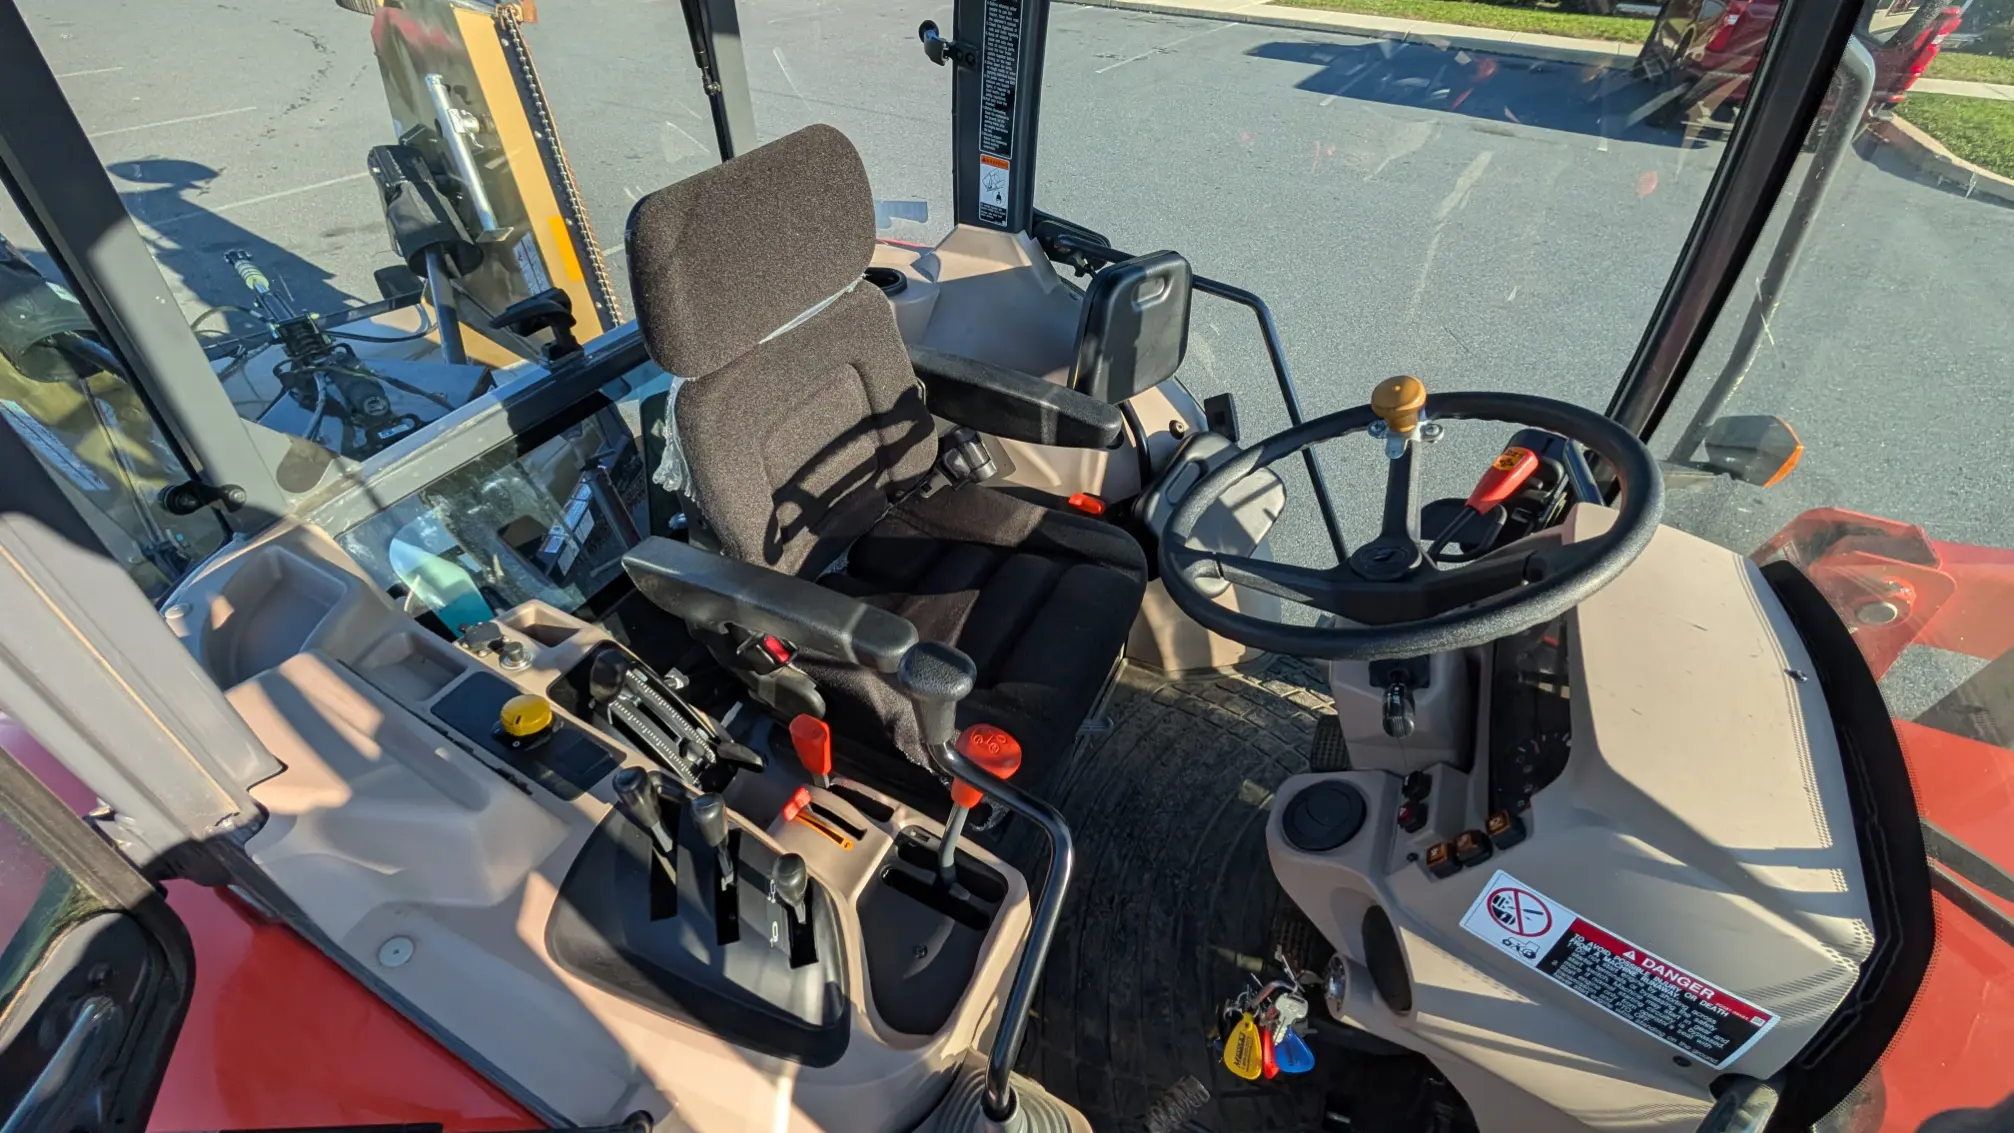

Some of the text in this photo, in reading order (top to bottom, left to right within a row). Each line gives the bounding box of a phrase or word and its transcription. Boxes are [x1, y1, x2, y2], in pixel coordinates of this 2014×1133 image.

[1569, 938, 1592, 952] FROM
[1603, 956, 1638, 976] MACHINE
[1640, 976, 1681, 999] RUNAWAY.
[1573, 933, 1586, 942] TO
[1587, 941, 1612, 956] AVOID
[1613, 955, 1652, 977] POSSIBLE
[1653, 976, 1682, 993] INJURY
[1684, 992, 1698, 1001] OR
[1699, 1000, 1729, 1017] DEATH
[1575, 947, 1586, 955] Do
[1588, 955, 1600, 963] not
[1602, 962, 1619, 973] start
[1620, 972, 1645, 987] engine
[1646, 986, 1657, 994] by
[1659, 993, 1689, 1010] shorting
[1691, 1010, 1716, 1024] across
[1641, 958, 1716, 999] DANGER
[1612, 982, 1643, 1000] Machine
[1645, 1000, 1661, 1010] may
[1664, 1009, 1681, 1019] start
[1693, 1025, 1711, 1035] gear
[1713, 1034, 1729, 1044] and
[1615, 1002, 1632, 1013] PTO
[1639, 989, 1676, 1010] bypassing
[1693, 1018, 1717, 1031] safety
[1677, 1029, 1693, 1039] seat
[1696, 1039, 1712, 1049] with
[1679, 1041, 1692, 1050] the
